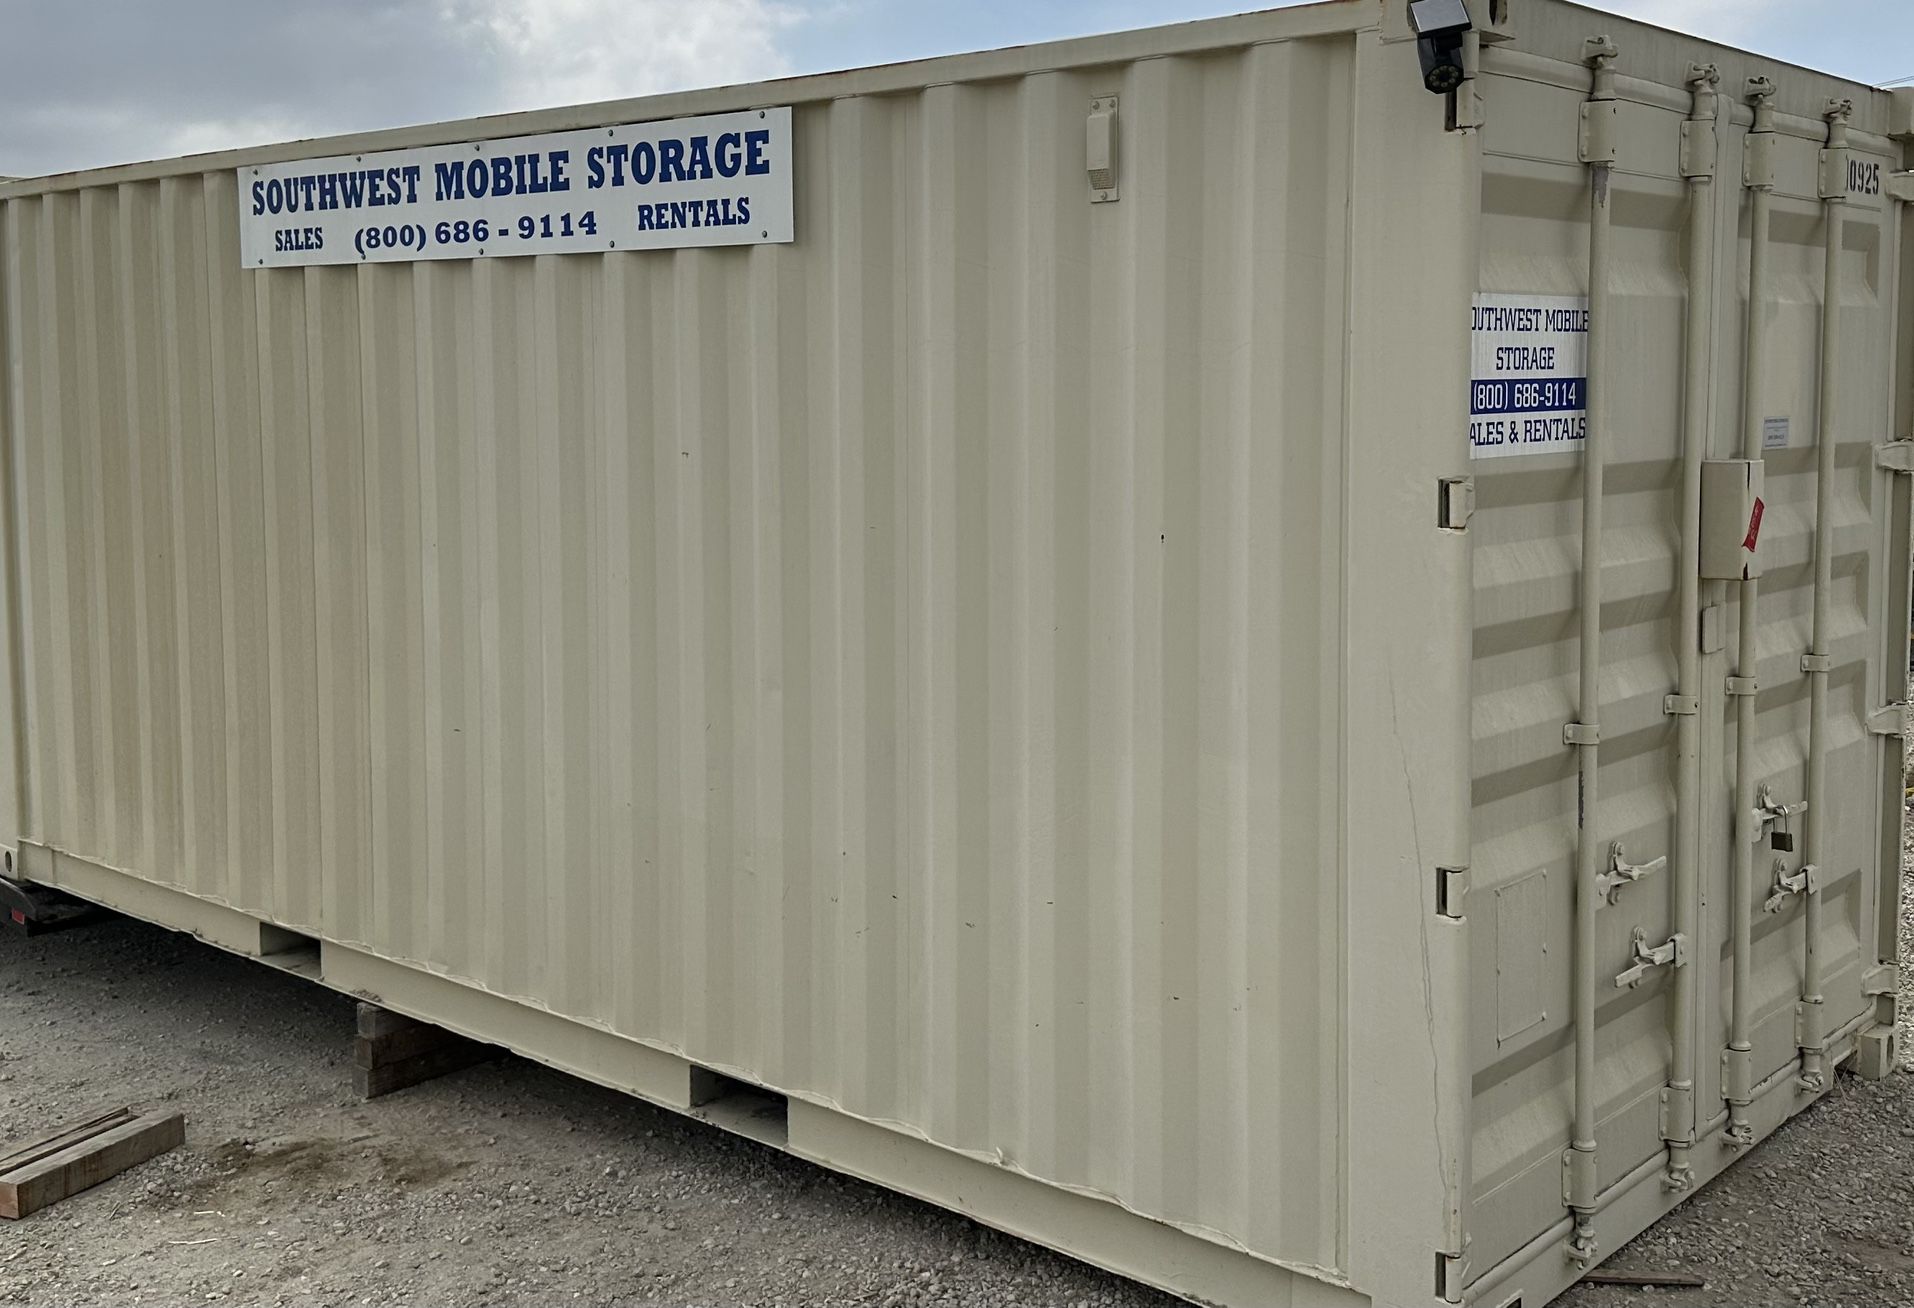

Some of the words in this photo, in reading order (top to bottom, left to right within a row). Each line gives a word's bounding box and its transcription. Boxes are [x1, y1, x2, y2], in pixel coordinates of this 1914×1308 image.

[252, 165, 420, 215] SOUTHWEST
[435, 150, 570, 201] MOBILE
[587, 129, 770, 189] STORAGE
[275, 227, 323, 252] SALES
[354, 224, 426, 255] (800)
[434, 219, 490, 245] 686
[518, 211, 597, 240] 9114
[638, 197, 750, 231] RENTALS
[1545, 309, 1588, 332] MOBILE
[1496, 347, 1555, 370] STORAGE
[1473, 381, 1508, 411] (800)
[1514, 382, 1576, 408] 686-9114
[1509, 420, 1519, 444] &
[1524, 417, 1586, 443] RENTALS
